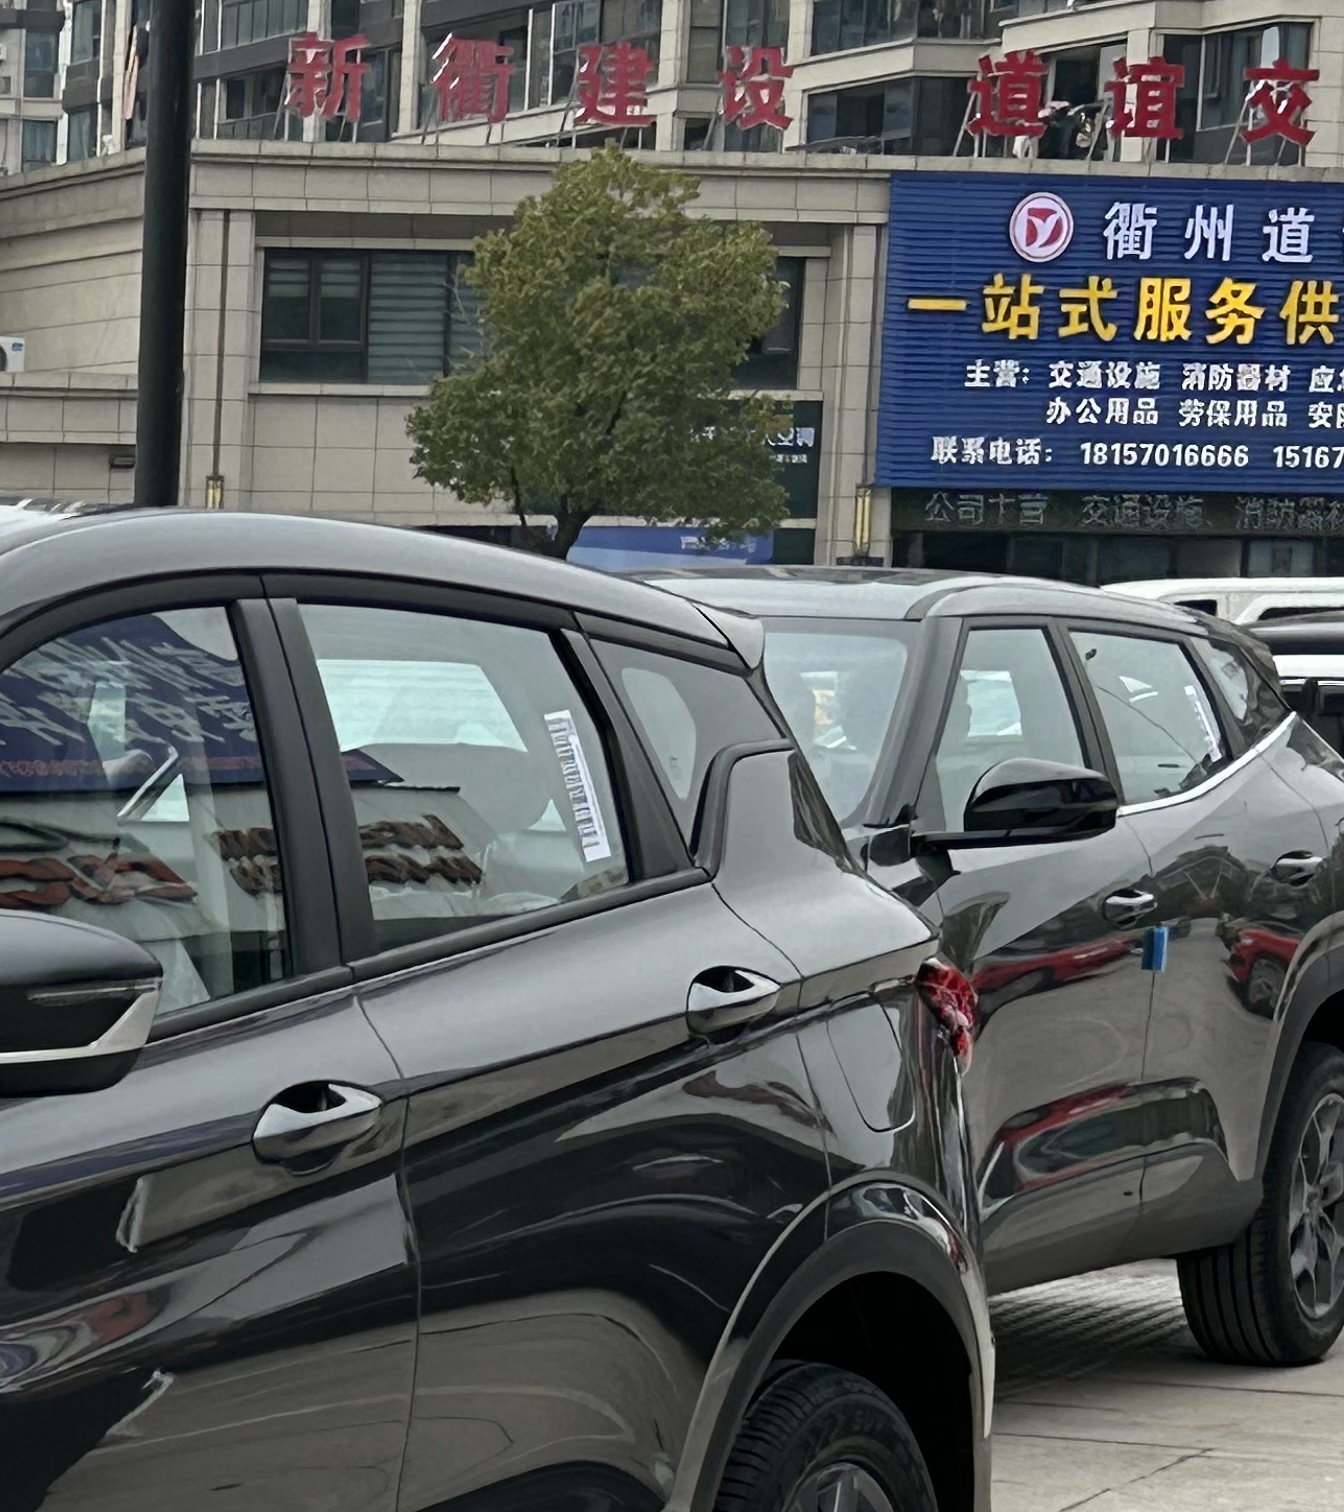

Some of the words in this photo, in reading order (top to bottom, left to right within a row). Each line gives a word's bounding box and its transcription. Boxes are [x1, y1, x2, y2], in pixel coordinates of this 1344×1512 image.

[286, 31, 793, 130] 新衢建设
[967, 50, 1320, 146] 道谊交
[1103, 200, 1344, 263] 衢州道
[907, 273, 1340, 345] 一站式服务供
[1048, 360, 1161, 390] 交通设施
[1181, 362, 1291, 392] 消防器材
[1045, 396, 1159, 425] 办公用品
[1178, 398, 1288, 428] 劳保用品
[1080, 442, 1249, 467] 18157016666
